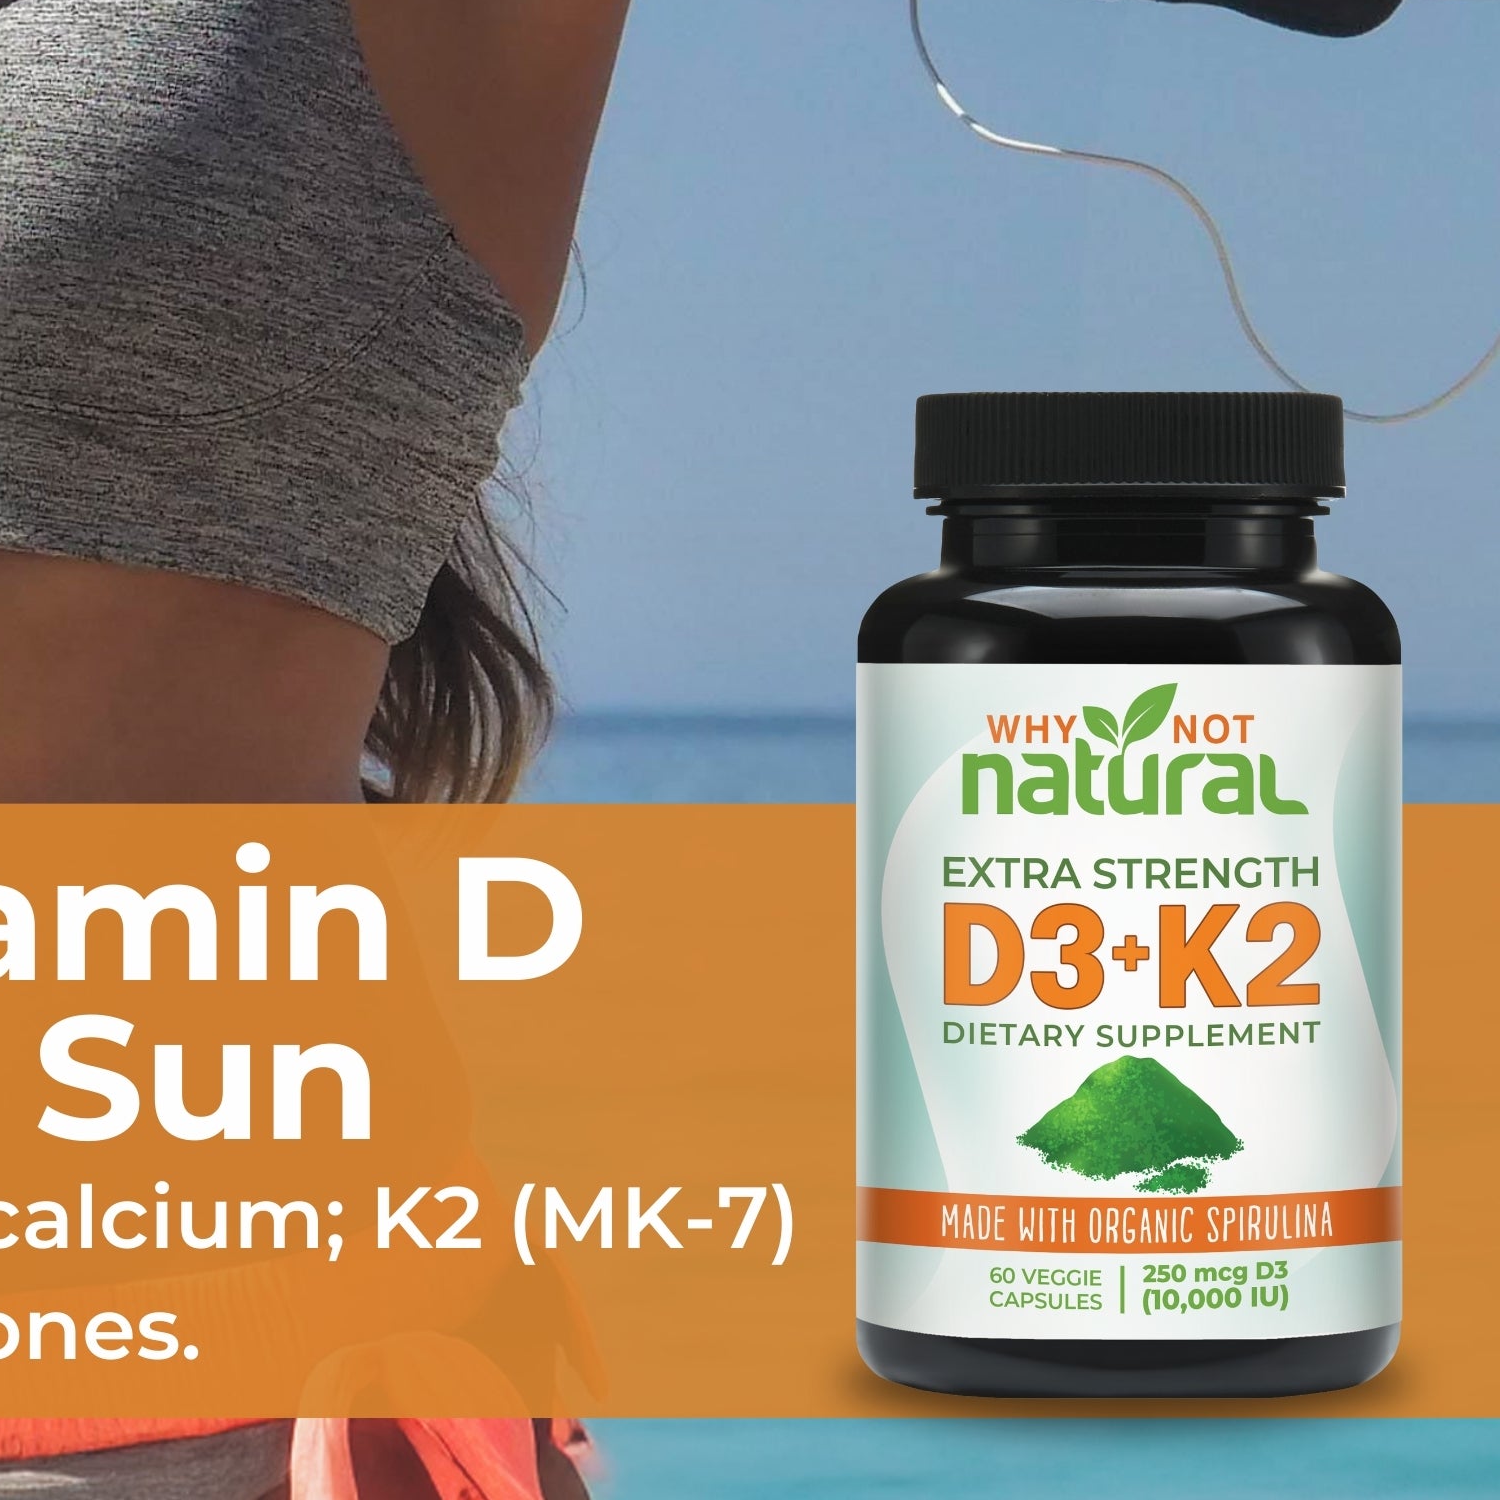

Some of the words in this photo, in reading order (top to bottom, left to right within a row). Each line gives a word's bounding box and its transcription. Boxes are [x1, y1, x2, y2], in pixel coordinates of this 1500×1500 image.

[986, 714, 1077, 744] WHY
[1173, 713, 1255, 745] NOT
[961, 737, 1310, 816] natural
[942, 856, 1082, 889] EXTRA
[1092, 855, 1320, 890] STRENGTH
[942, 900, 1322, 1011] D3+K2
[942, 1021, 1085, 1048] DIETARY
[1096, 1020, 1322, 1048] SUPPLEMENT
[941, 1203, 1006, 1242] MADE
[1018, 1206, 1076, 1244] WITH
[1088, 1205, 1195, 1245] ORGANIC
[1206, 1201, 1334, 1243] SPIRULINA
[989, 1267, 1016, 1284] 60
[1022, 1269, 1102, 1286] VEGGIE
[1142, 1263, 1187, 1283] 250
[1193, 1265, 1248, 1285] mcg
[1255, 1260, 1289, 1280] D3
[989, 1290, 1103, 1310] CAPSULES
[1142, 1287, 1242, 1315] (10,000
[1251, 1285, 1289, 1311] IU)
